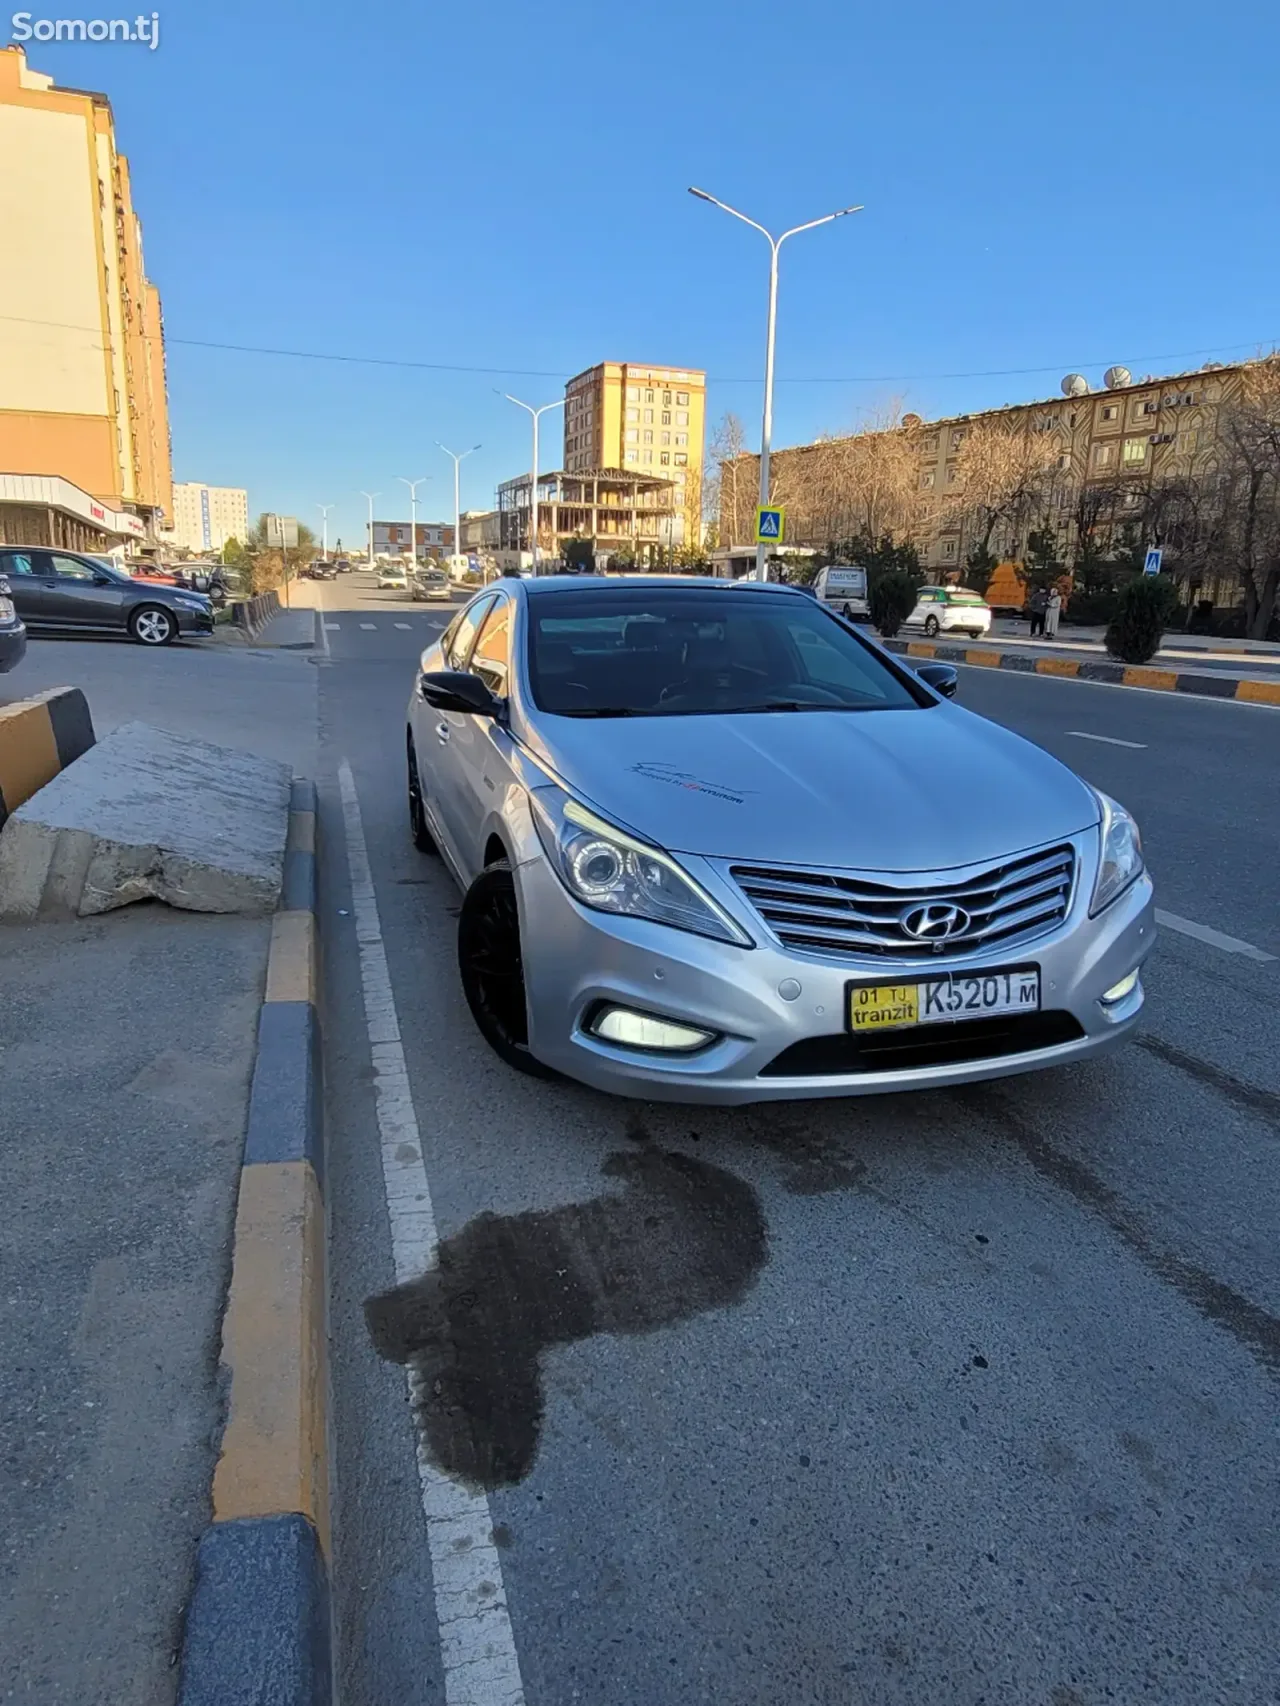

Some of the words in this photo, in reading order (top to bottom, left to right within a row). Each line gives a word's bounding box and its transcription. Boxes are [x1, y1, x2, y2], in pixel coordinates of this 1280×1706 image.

[859, 989, 878, 1005] 01
[889, 987, 907, 1002] TJ
[924, 974, 1012, 1015] K5201
[1019, 984, 1037, 1004] M
[854, 1003, 914, 1024] tranzit
